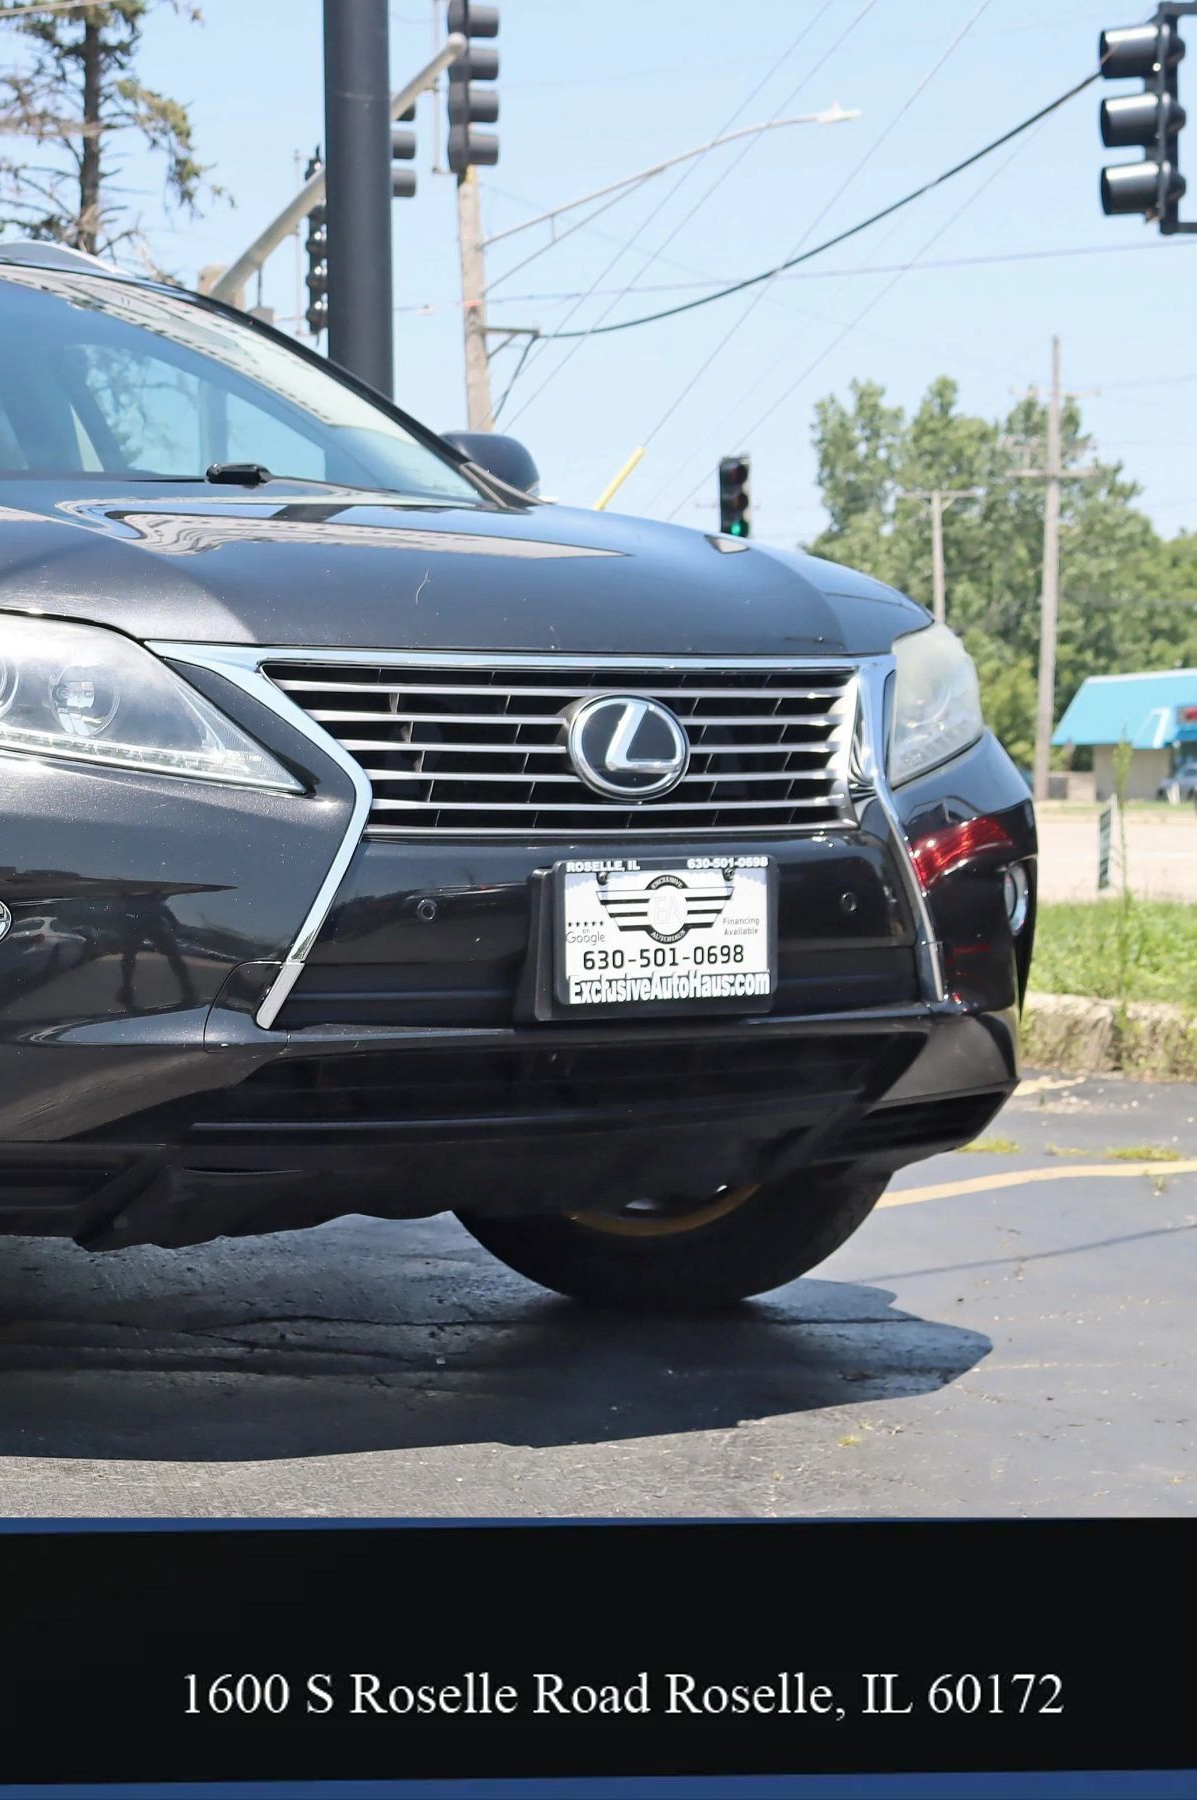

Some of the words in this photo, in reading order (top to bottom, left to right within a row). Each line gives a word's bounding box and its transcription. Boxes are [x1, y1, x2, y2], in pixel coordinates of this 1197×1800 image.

[566, 860, 625, 873] ROSELLE,
[627, 859, 641, 871] IL
[686, 856, 769, 870] 630-501-0698
[723, 917, 760, 926] Financing
[566, 931, 606, 946] Google
[724, 928, 759, 936] Available
[583, 944, 745, 970] 630-501-0698
[569, 970, 770, 1004] ExclusiveAutoHaus.com
